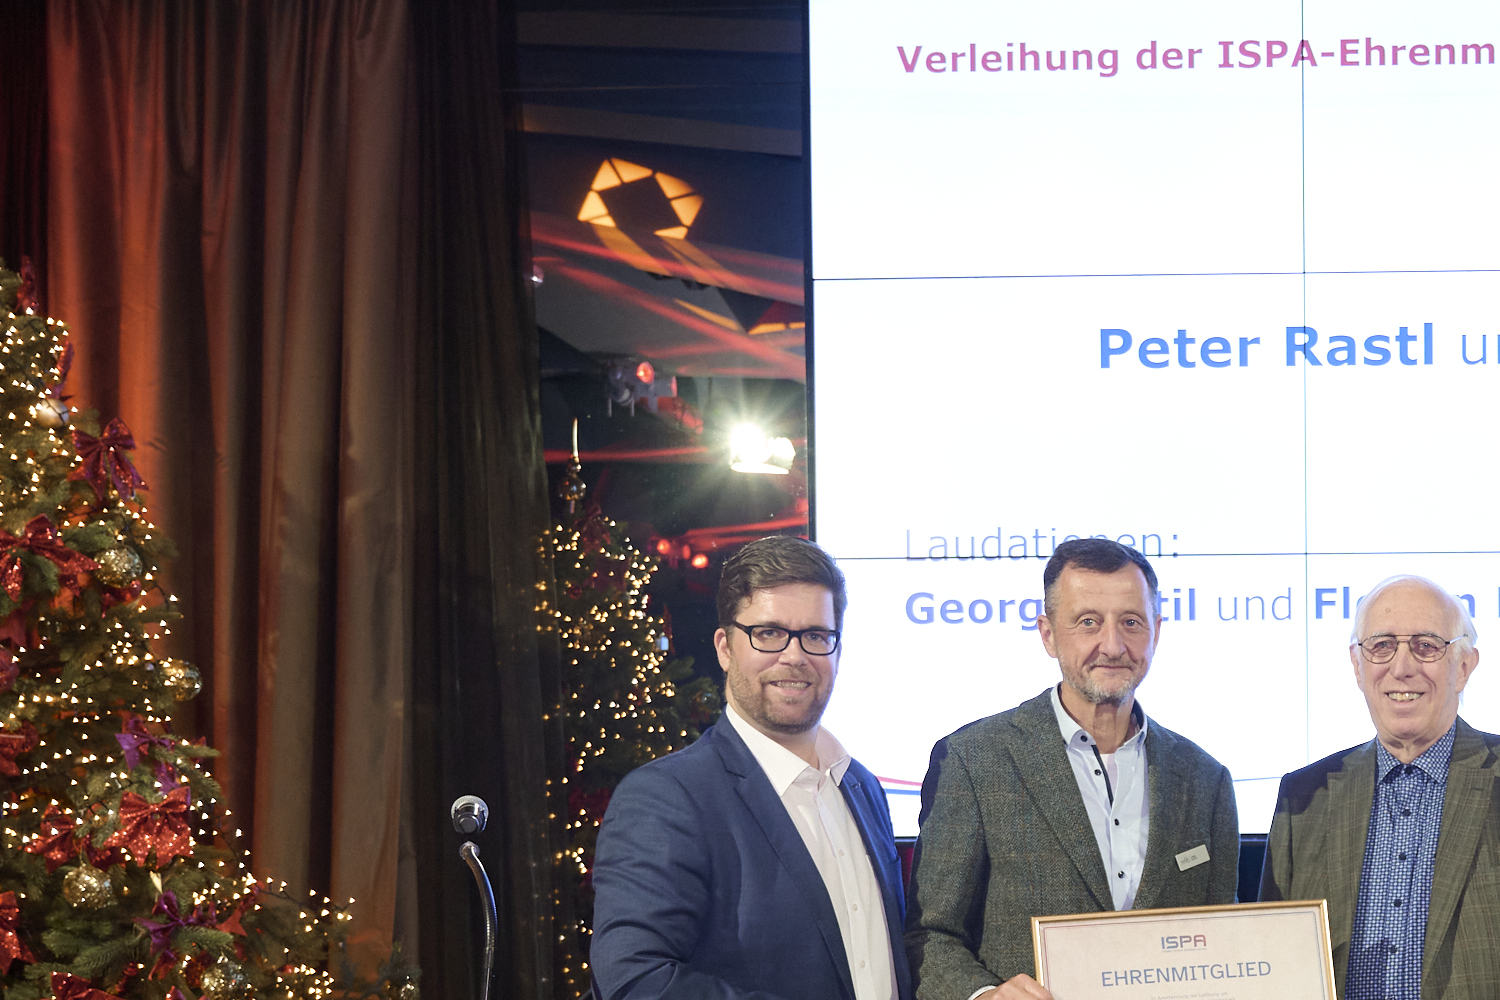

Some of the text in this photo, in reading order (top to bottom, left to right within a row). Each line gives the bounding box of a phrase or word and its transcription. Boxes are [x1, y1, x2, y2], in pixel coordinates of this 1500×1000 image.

[897, 42, 1120, 77] Verleihung
[1136, 42, 1203, 70] der
[1101, 328, 1261, 369] Peter
[1286, 323, 1434, 367] Rastl
[906, 591, 1045, 632] Georg
[1217, 587, 1292, 622] und
[1161, 934, 1207, 949] ISPA
[1101, 960, 1272, 987] EHRENMITGLIED
